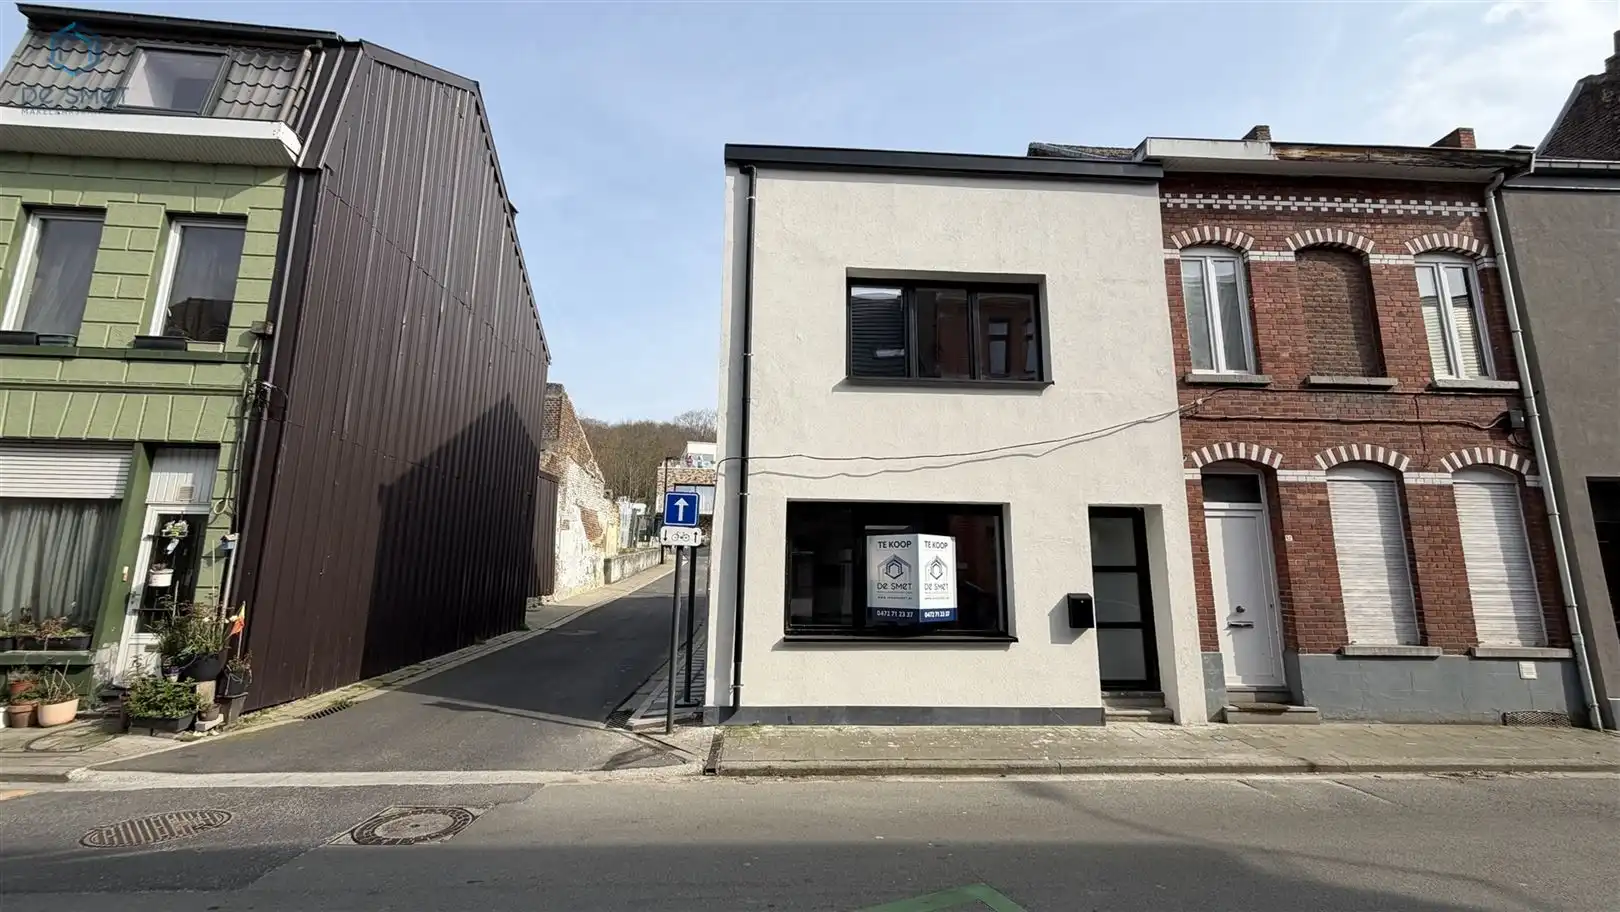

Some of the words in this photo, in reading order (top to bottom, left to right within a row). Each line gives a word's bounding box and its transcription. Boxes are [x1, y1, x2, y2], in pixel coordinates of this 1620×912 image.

[889, 540, 912, 548] KOOP
[924, 540, 932, 548] TE
[932, 541, 948, 549] KOOP
